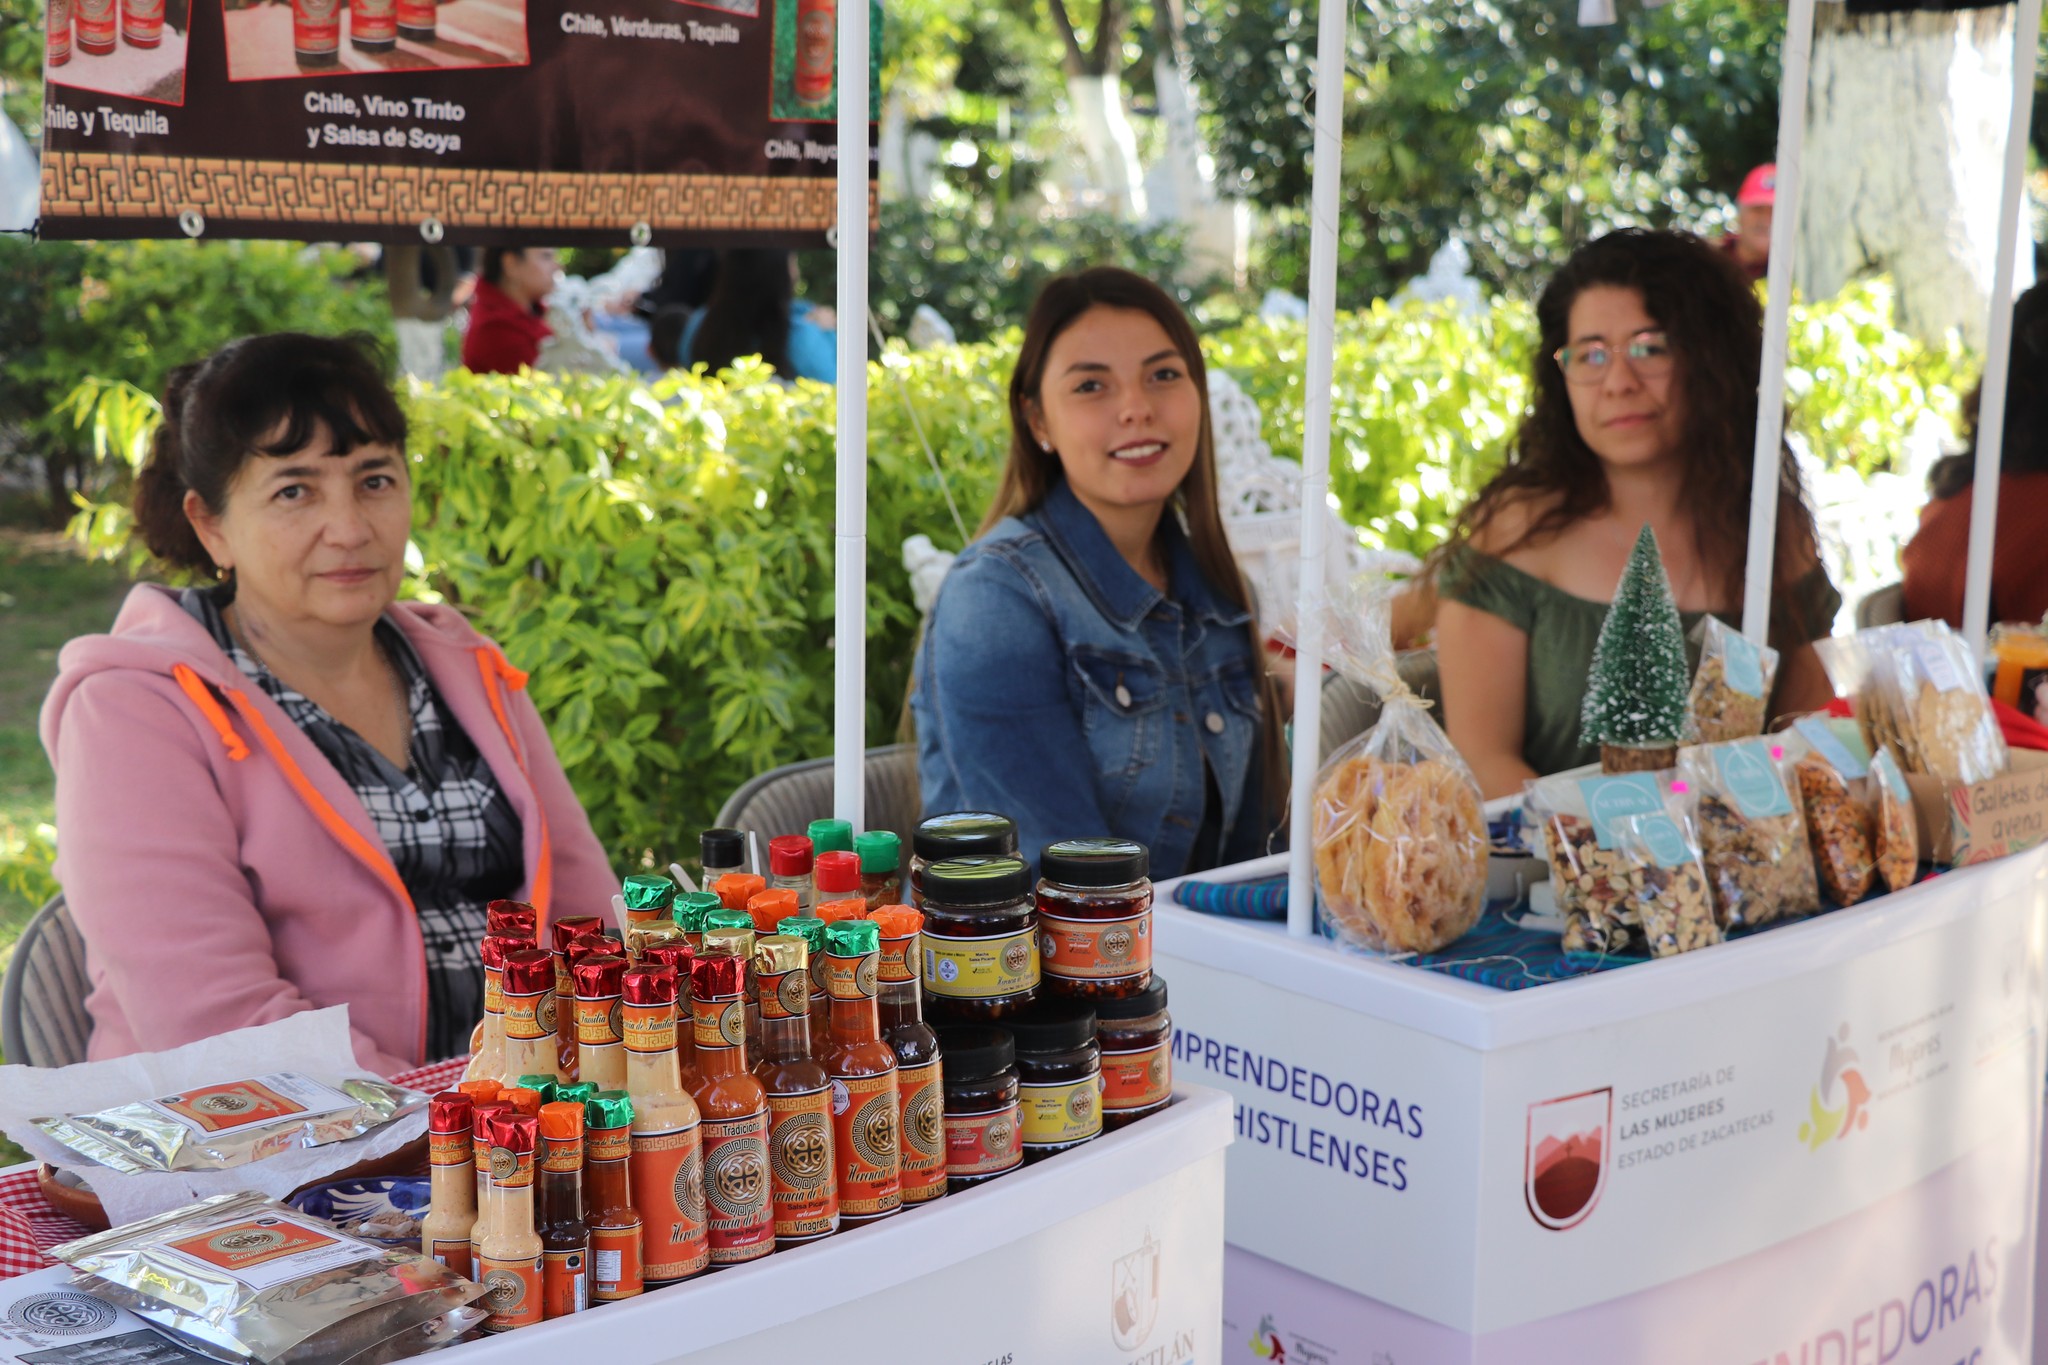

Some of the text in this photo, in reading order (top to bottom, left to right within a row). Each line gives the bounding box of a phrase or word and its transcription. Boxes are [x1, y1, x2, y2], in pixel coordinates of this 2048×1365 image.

[560, 12, 740, 46] Chile, Verduras, Tequila
[304, 91, 466, 122] Chile, Vino Tinto
[46, 104, 170, 138] hile y Tequila
[307, 123, 461, 154] y Salsa de Soya
[509, 1005, 533, 1020] Familia
[579, 1010, 606, 1024] Familia
[645, 1017, 675, 1031] Familia
[1171, 1029, 1423, 1139] MPRENDEDORAS
[1621, 1065, 1736, 1111] SECRETARÍA DE
[1620, 1098, 1725, 1140] LAS MUJERES
[1234, 1105, 1408, 1191] HISTLENSES
[1618, 1110, 1775, 1170] ESTADO DE ZACATECAS
[901, 1152, 935, 1170] Herencia
[848, 1164, 887, 1182] Herencia
[870, 1181, 888, 1189] Salsa
[927, 1186, 935, 1197] La
[787, 1202, 807, 1210] Salsa
[724, 1230, 745, 1238] Salsa
[794, 1218, 829, 1233] Vinagreta
